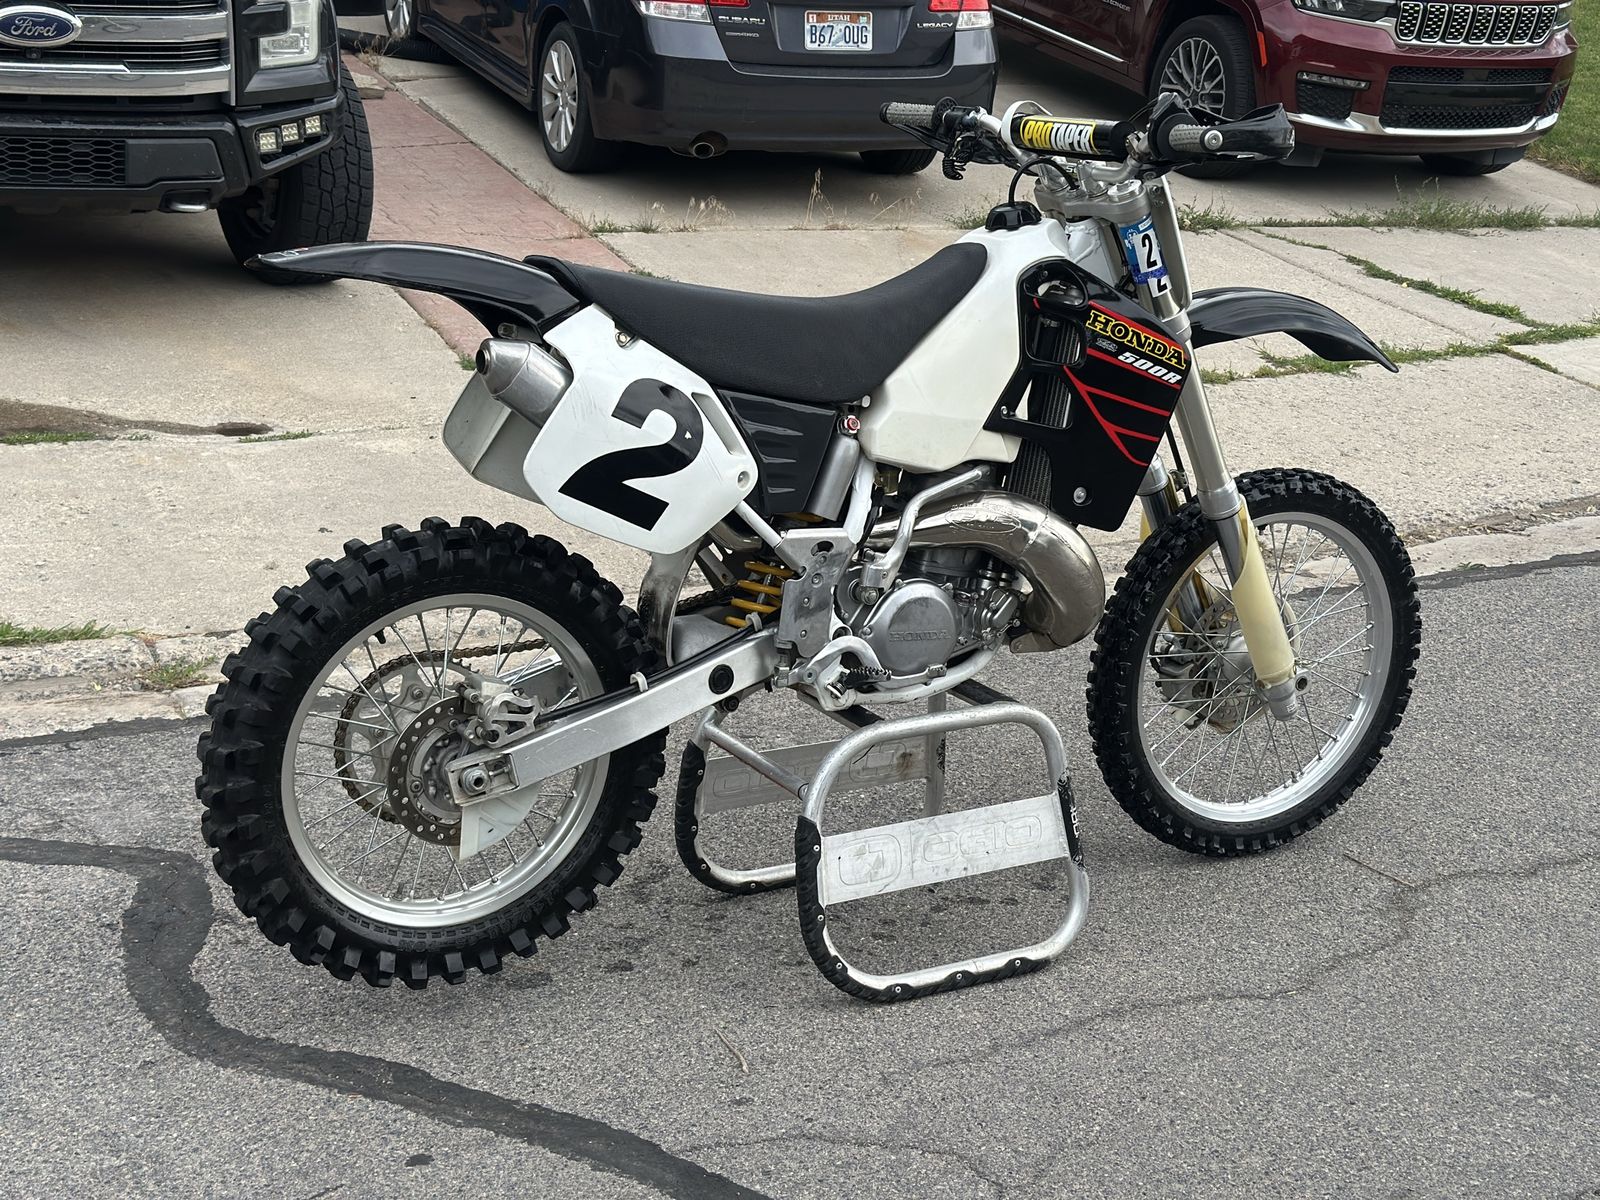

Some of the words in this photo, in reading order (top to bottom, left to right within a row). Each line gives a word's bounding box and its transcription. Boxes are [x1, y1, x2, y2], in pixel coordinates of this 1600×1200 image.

[11, 16, 57, 36] Ford
[718, 16, 765, 25] SUBARU
[810, 25, 834, 44] B67
[1141, 233, 1158, 269] 2
[1086, 310, 1187, 370] HONDA
[1117, 351, 1182, 384] 500R
[558, 377, 704, 532] 2
[889, 629, 952, 642] HONDA
